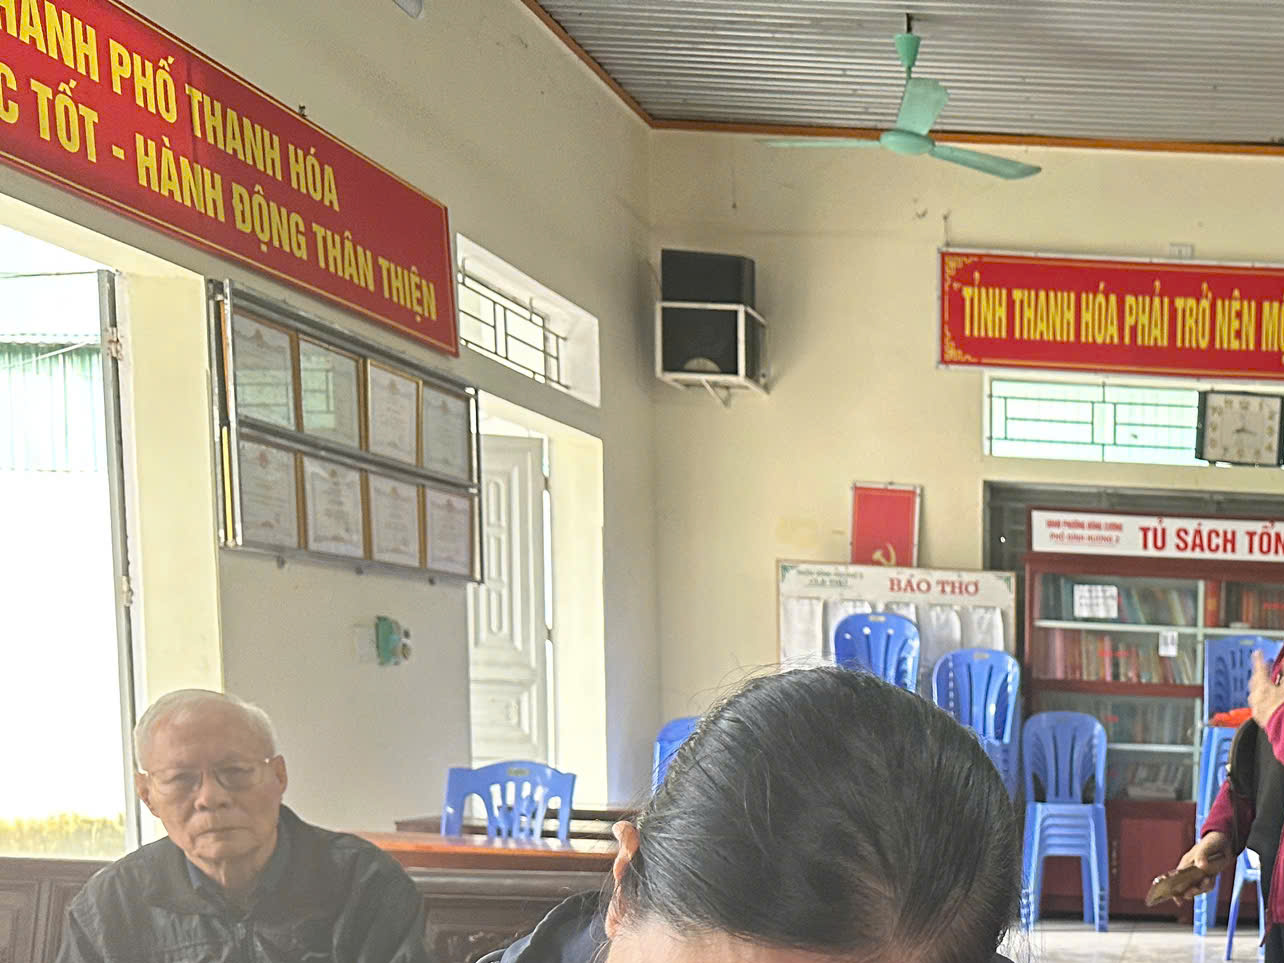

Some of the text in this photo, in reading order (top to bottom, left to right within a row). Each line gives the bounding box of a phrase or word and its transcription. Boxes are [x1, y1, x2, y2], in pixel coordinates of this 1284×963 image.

[109, 38, 179, 124] PHỐ
[186, 86, 282, 182] THANH
[288, 144, 340, 211] HÓA
[30, 78, 98, 163] TỐT
[135, 134, 225, 222] HÀNH
[231, 182, 308, 260] ĐỘNG
[312, 223, 374, 293] THÂN
[378, 256, 437, 322] THIỆN
[962, 271, 1008, 338] TỈNH
[1012, 288, 1075, 342] THANH
[1080, 281, 1118, 344] HÓA
[1124, 280, 1169, 347] PHẢI
[1174, 281, 1212, 349] TRỞ
[1215, 288, 1256, 350] NÊN
[1139, 516, 1166, 550] TỦ
[1175, 524, 1236, 554] SÁCH
